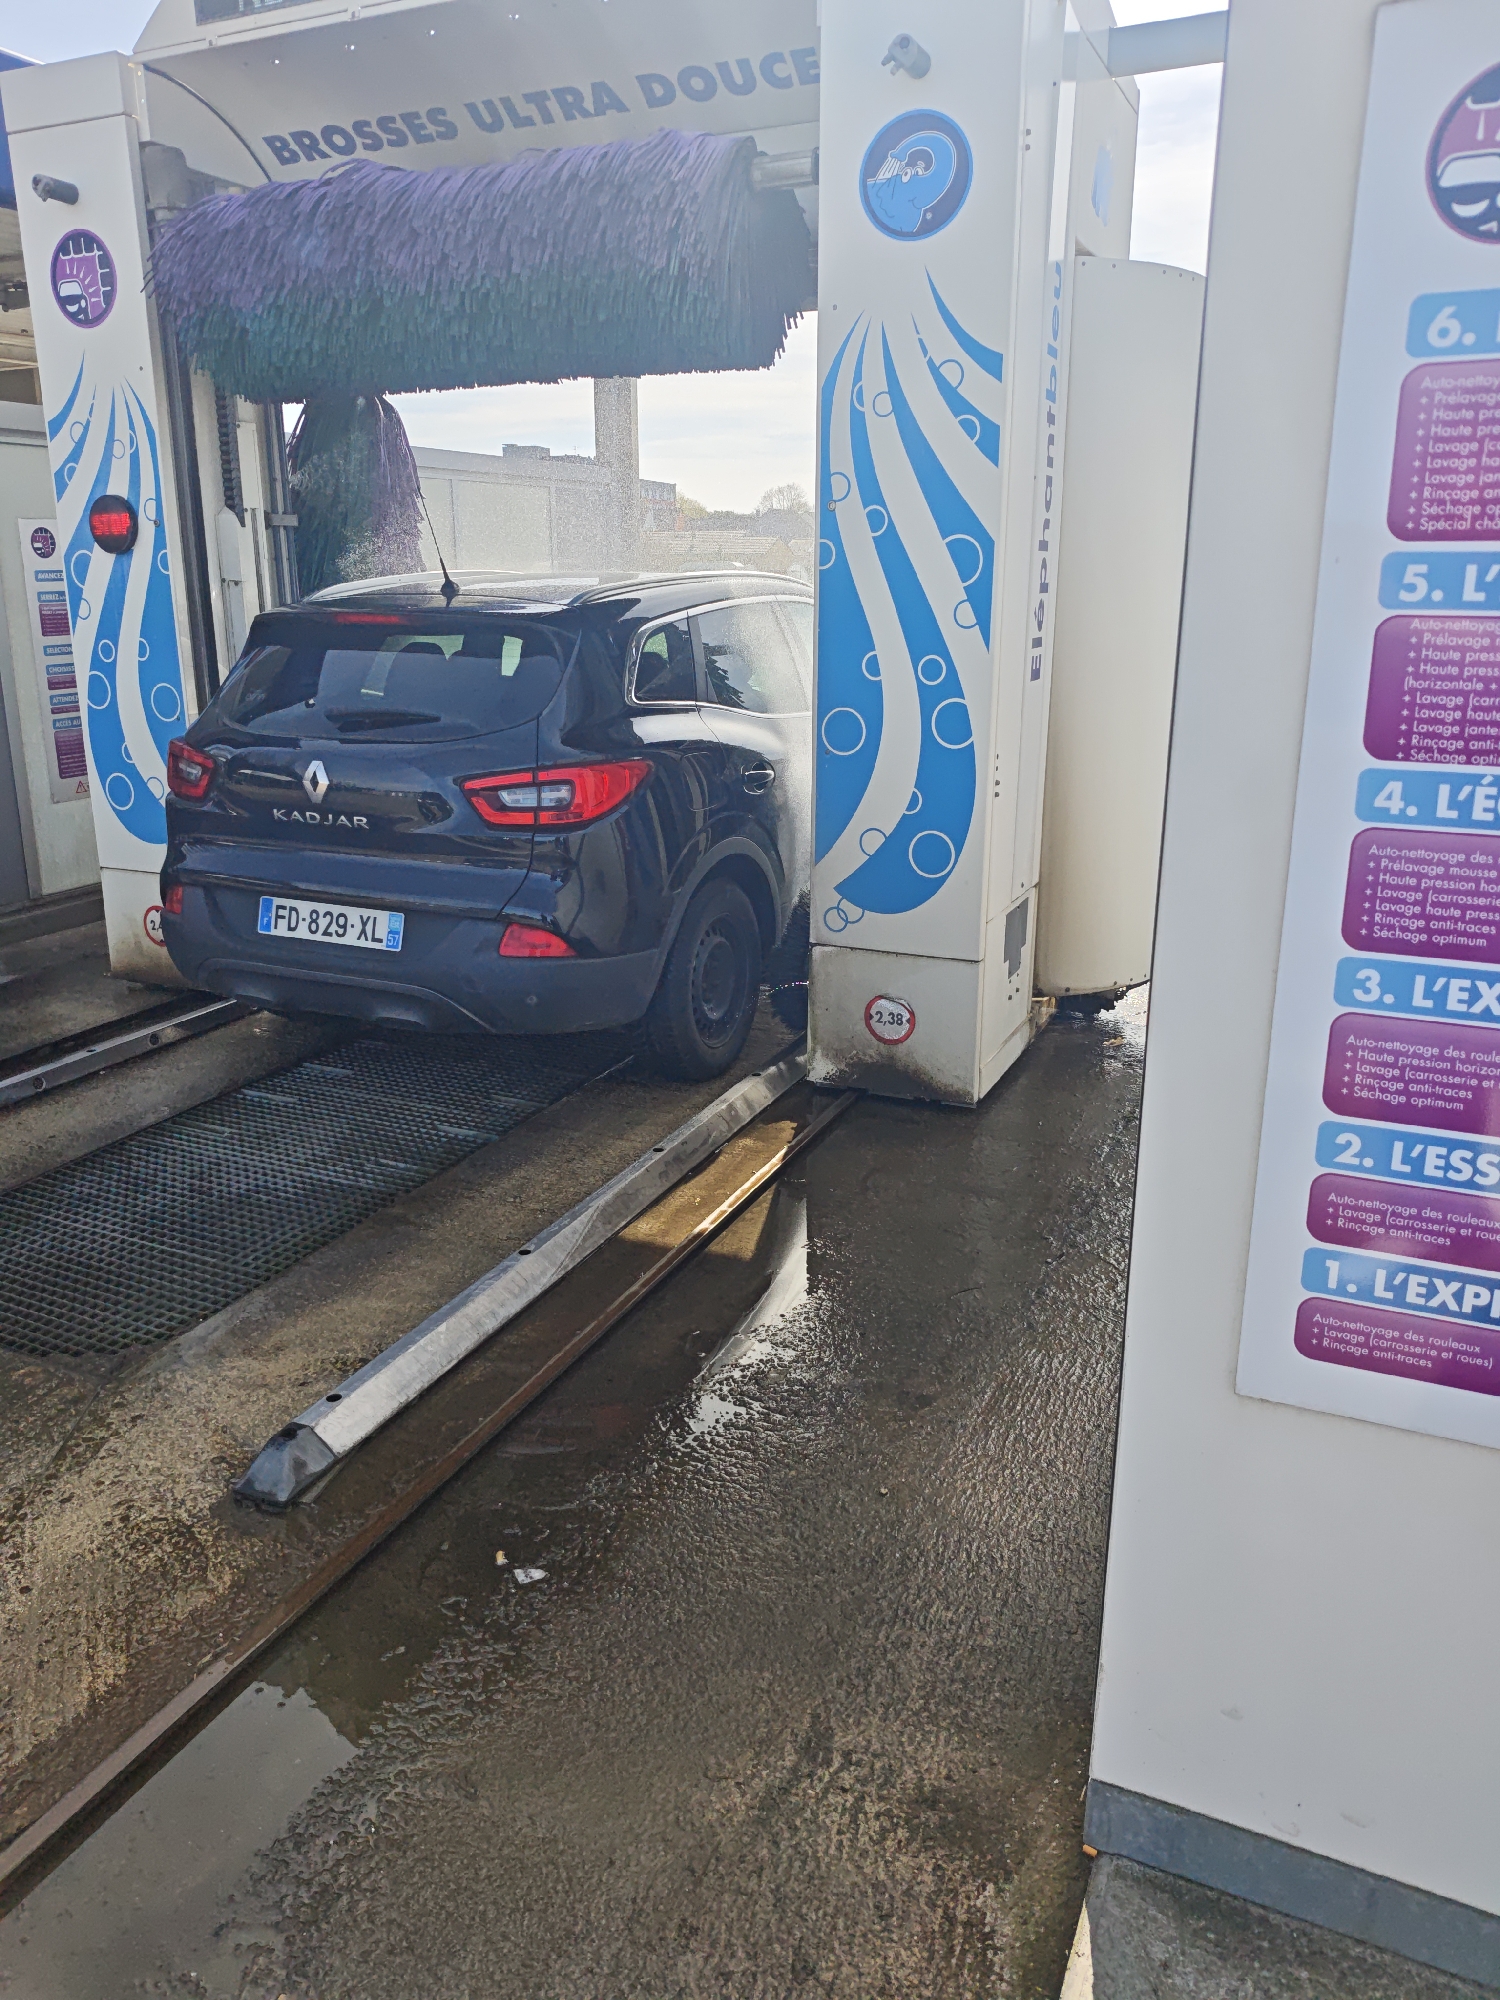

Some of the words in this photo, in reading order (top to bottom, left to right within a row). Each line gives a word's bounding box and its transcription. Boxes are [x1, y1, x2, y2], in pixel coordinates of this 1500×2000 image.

[262, 106, 459, 167] BROSSES
[463, 80, 631, 134] ULTRA
[635, 46, 821, 110] DOUCE
[1427, 305, 1477, 349] 6.
[1421, 376, 1500, 391] Auto-nettoy
[1432, 408, 1475, 420] Haute
[1430, 424, 1473, 436] Haute
[1428, 439, 1479, 455] Lavage
[1426, 455, 1477, 471] Lavage
[1424, 470, 1475, 487] Lavage
[1423, 486, 1479, 502] Rinçage
[1421, 501, 1481, 518] Séchage
[1419, 517, 1470, 533] Spécial
[1398, 563, 1445, 603] 5.
[1423, 631, 1490, 649] Prélavage
[1421, 646, 1461, 660] Haute
[1419, 661, 1459, 675] Haute
[1404, 676, 1484, 691] (horizontale
[1416, 691, 1464, 708] Lavage
[1414, 706, 1462, 722] Lavage
[1413, 720, 1460, 737] Lavage
[1464, 723, 1500, 738] jante
[1411, 734, 1465, 751] Rinçage
[1409, 748, 1467, 765] Séchage
[1471, 752, 1500, 767] opti
[1373, 780, 1418, 817] 4.
[1436, 774, 1500, 822] L'É
[272, 808, 370, 830] KADJAR
[1369, 844, 1466, 864] Auto-nettoyage
[1470, 850, 1493, 864] des
[1380, 858, 1445, 877] Prélavage
[1449, 866, 1498, 879] mousse
[1379, 872, 1417, 886] Haute
[1421, 878, 1476, 891] pression
[1377, 885, 1423, 903] Lavage
[1375, 899, 1421, 916] Lavage
[1426, 903, 1461, 918] haute
[1374, 912, 1426, 930] Rinçage
[1429, 918, 1497, 935] anti-traces
[387, 933, 400, 947] 57
[1372, 925, 1428, 944] Séchage
[1431, 933, 1487, 947] optimum
[1353, 968, 1395, 1005] 3.
[874, 1010, 904, 1027] 2,38
[1345, 1034, 1440, 1057] Auto-nettoyage
[1443, 1045, 1466, 1059] des
[1358, 1048, 1395, 1063] Haute
[1398, 1056, 1451, 1070] pression
[1356, 1061, 1400, 1079] Lavage
[1405, 1066, 1479, 1087] (carrosserie
[1482, 1079, 1495, 1089] et
[1354, 1072, 1405, 1092] Rinçage
[1408, 1083, 1473, 1099] anti-traces
[1353, 1085, 1407, 1105] Séchage
[1410, 1096, 1464, 1111] optimum
[1333, 1132, 1375, 1168] 2.
[1327, 1192, 1418, 1217] Auto-nettoyage
[1421, 1206, 1443, 1219] des
[1338, 1205, 1382, 1223] Lavage
[1385, 1210, 1457, 1234] (carrosserie
[1460, 1227, 1472, 1237] et
[1337, 1217, 1386, 1236] Rinçage
[1389, 1228, 1452, 1247] anti-traces
[1325, 1259, 1358, 1293] 1.
[1313, 1312, 1400, 1339] Auto-nettoyage
[1403, 1330, 1425, 1342] des
[1428, 1337, 1482, 1354] rouleaux
[1322, 1337, 1369, 1357] Rinçage
[1372, 1349, 1433, 1369] anti-traces
[1324, 1326, 1365, 1344] Lavage
[1369, 1333, 1438, 1357] (carrosserie
[1441, 1351, 1453, 1360] et
[1456, 1354, 1494, 1371] roues)
